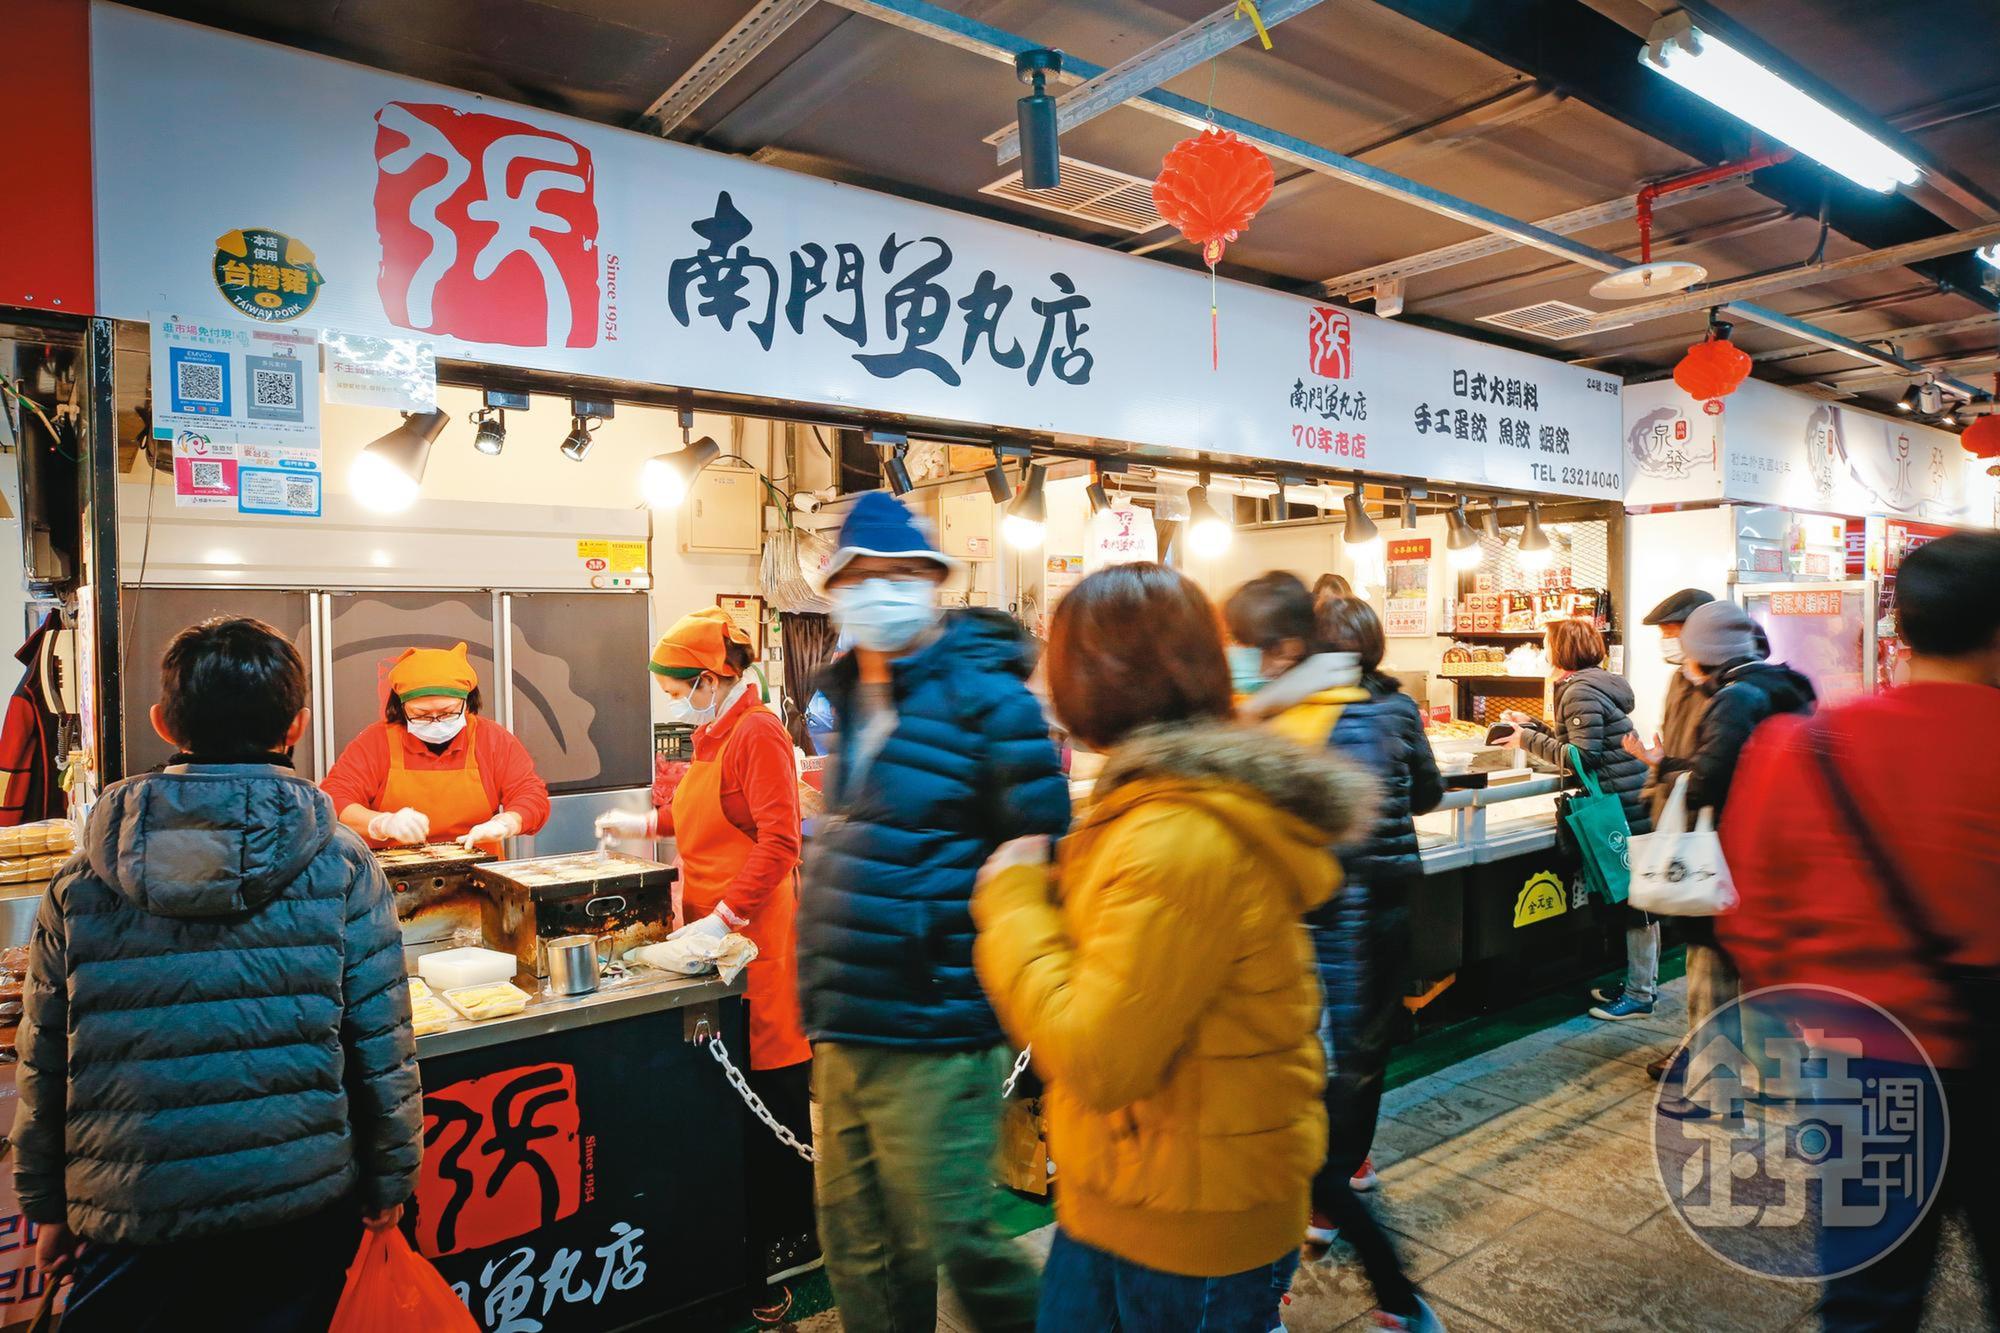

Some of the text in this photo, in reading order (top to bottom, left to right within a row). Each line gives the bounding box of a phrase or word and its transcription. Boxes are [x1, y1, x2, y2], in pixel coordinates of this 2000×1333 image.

[253, 234, 279, 249] 本店
[253, 247, 279, 262] 使用
[222, 259, 308, 295] 台灣豬
[232, 295, 303, 321] TAIWAN PORK
[605, 253, 620, 342] Since 1954
[1452, 369, 1539, 412] 日式火鍋料
[1291, 423, 1367, 460] 70年老店
[1414, 402, 1570, 455] 手工蛋餃 魚餃 蝦餃
[1530, 462, 1621, 490] TEL 23214040
[584, 1134, 597, 1203] Since 1954
